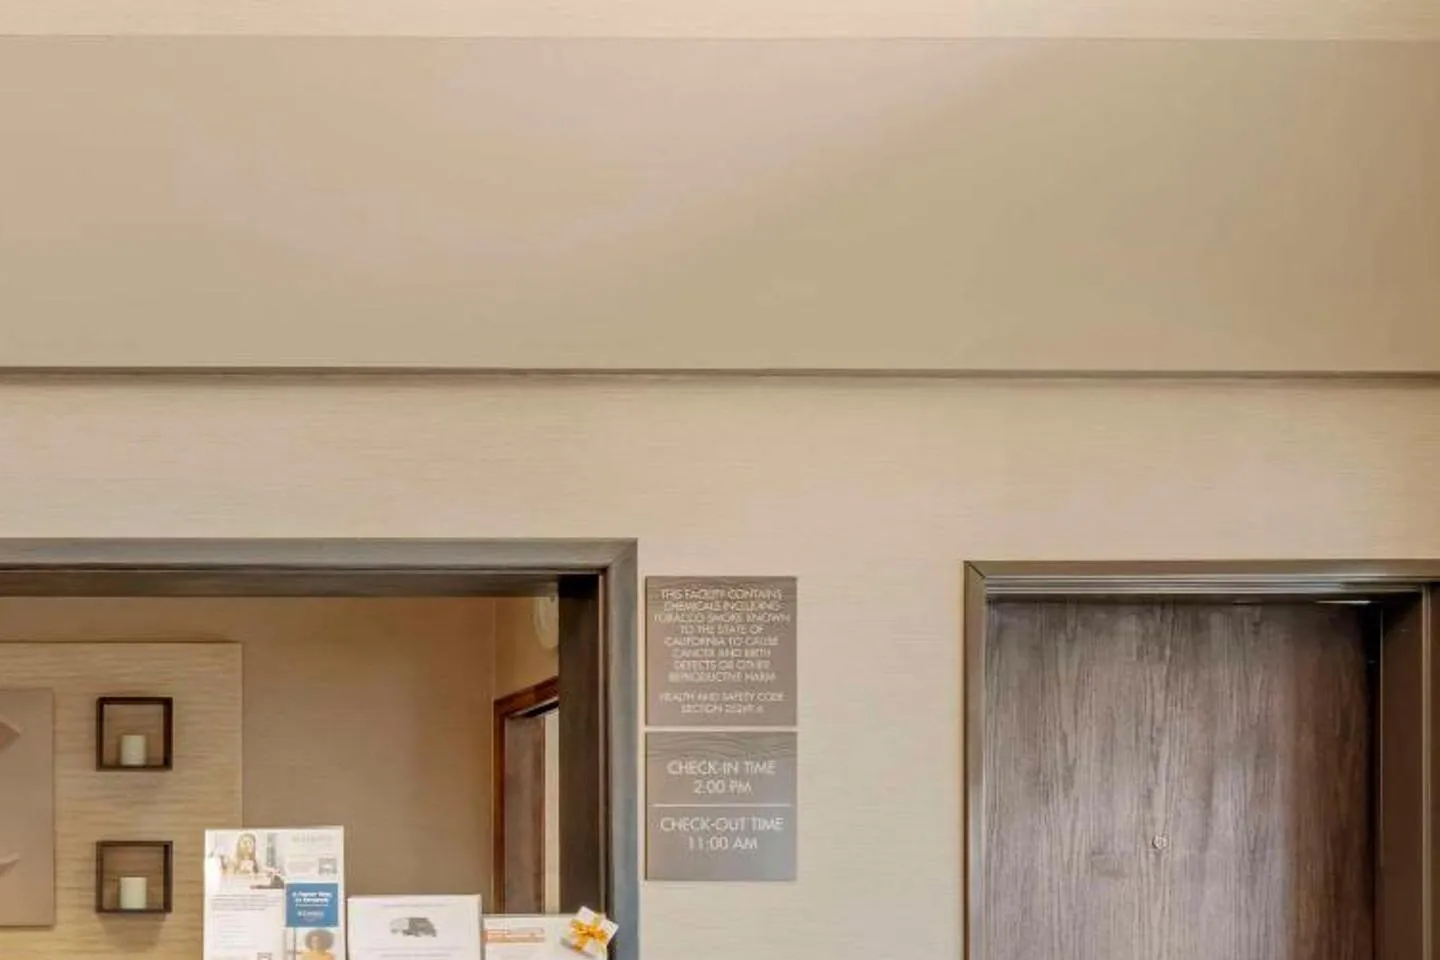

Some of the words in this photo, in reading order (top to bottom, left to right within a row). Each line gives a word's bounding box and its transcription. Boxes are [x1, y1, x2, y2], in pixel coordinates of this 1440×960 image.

[727, 588, 782, 600] CONTAINS
[698, 624, 715, 634] THE
[717, 624, 747, 634] STATE
[748, 624, 764, 634] OF
[666, 760, 739, 775] CHECK-IN
[744, 760, 777, 775] TIME
[693, 779, 725, 794] 2:00
[729, 779, 752, 794] PM
[660, 817, 745, 832] CHECK-OUT
[751, 817, 784, 832] TIME
[688, 836, 728, 850] 11:00
[732, 836, 758, 850] AM
